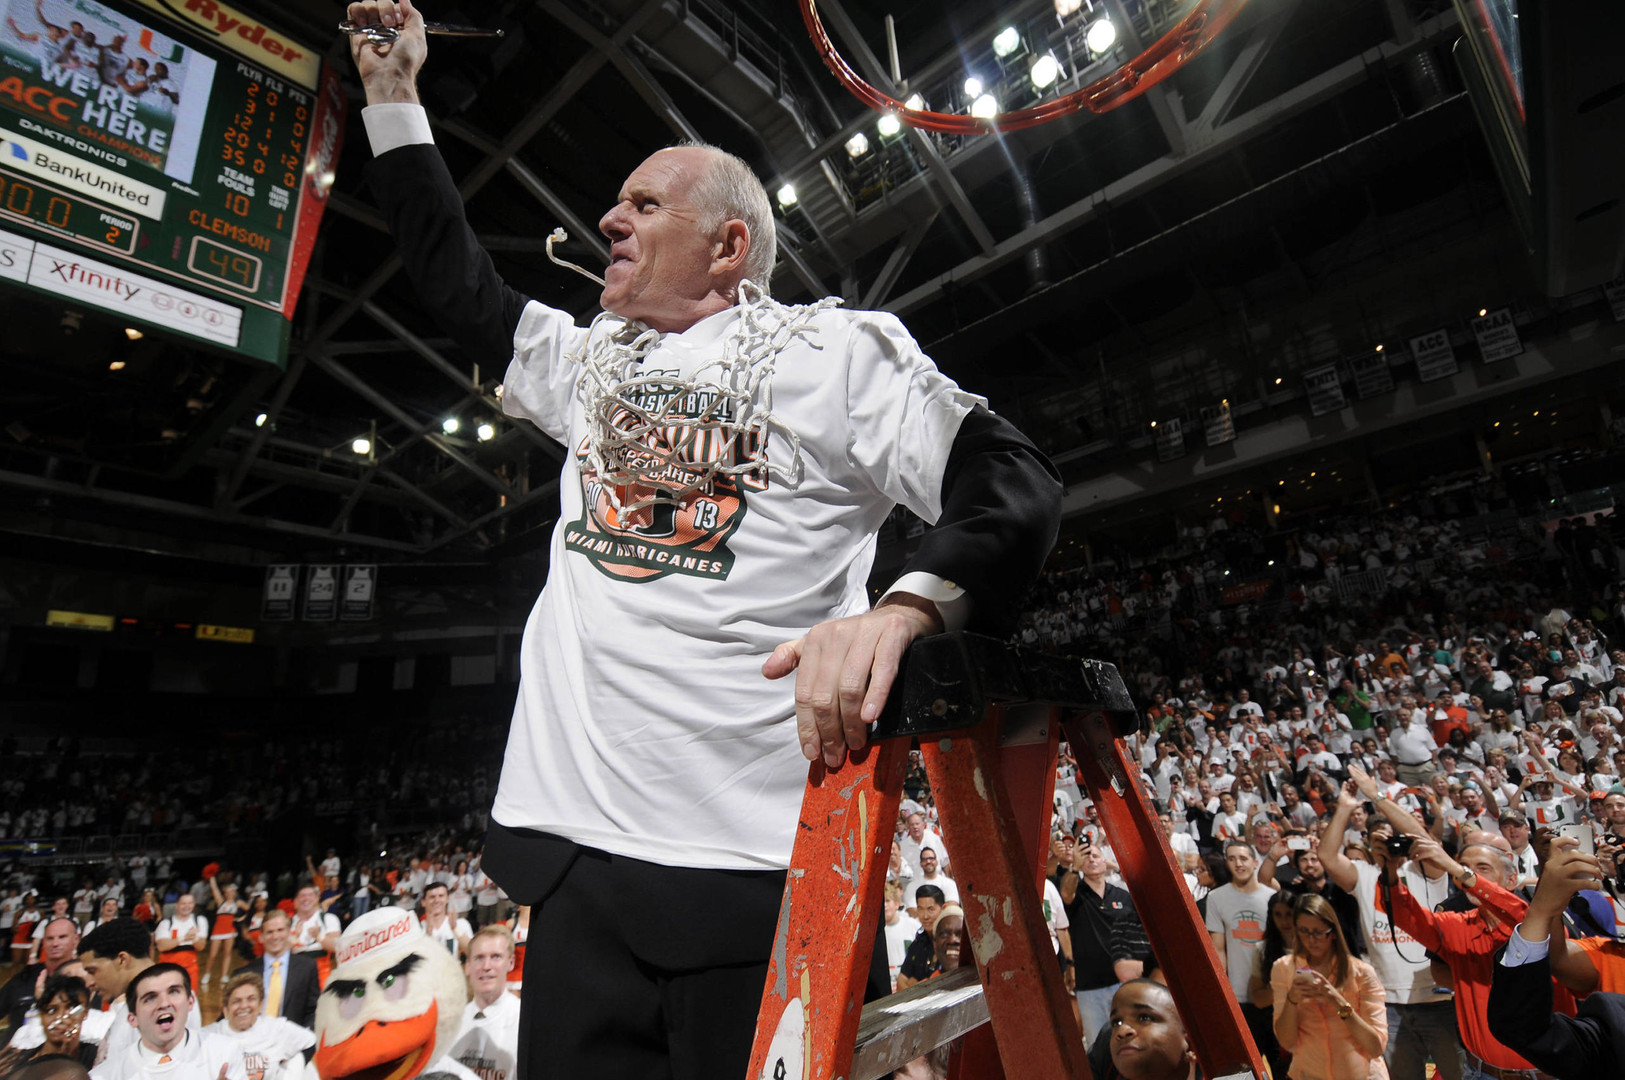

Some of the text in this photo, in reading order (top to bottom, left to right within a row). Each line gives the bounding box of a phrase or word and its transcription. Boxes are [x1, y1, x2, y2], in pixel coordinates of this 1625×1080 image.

[184, 0, 303, 63] Ryder
[0, 76, 78, 122] ACC
[39, 56, 140, 119] WE'RE
[237, 62, 307, 105] PLYR FLS PTS
[247, 82, 307, 121] 2 0 0
[81, 100, 168, 154] HERE
[233, 113, 253, 132] 12
[290, 139, 302, 154] 4
[244, 98, 257, 115] 3
[292, 121, 305, 138] 0
[18, 118, 128, 168] DAKTRONICS
[76, 124, 163, 168] CHAMPIONS
[224, 126, 299, 171] 20 4 12
[34, 153, 150, 206] BankUnited
[217, 173, 256, 197] FOULS
[221, 143, 296, 188] 35 0 0
[223, 166, 255, 187] TEAM
[99, 213, 134, 232] PERIOD
[189, 209, 271, 253] CLEMSON
[225, 192, 283, 230] 10 1
[105, 226, 121, 243] 2
[50, 260, 140, 301] xfinity
[209, 249, 251, 285] 49
[1418, 333, 1445, 353] ACC
[1473, 313, 1511, 334] NCAA
[692, 499, 718, 530] 13
[566, 530, 613, 555] MIAMI
[616, 543, 723, 574] HURRICANES
[353, 582, 365, 594] 2
